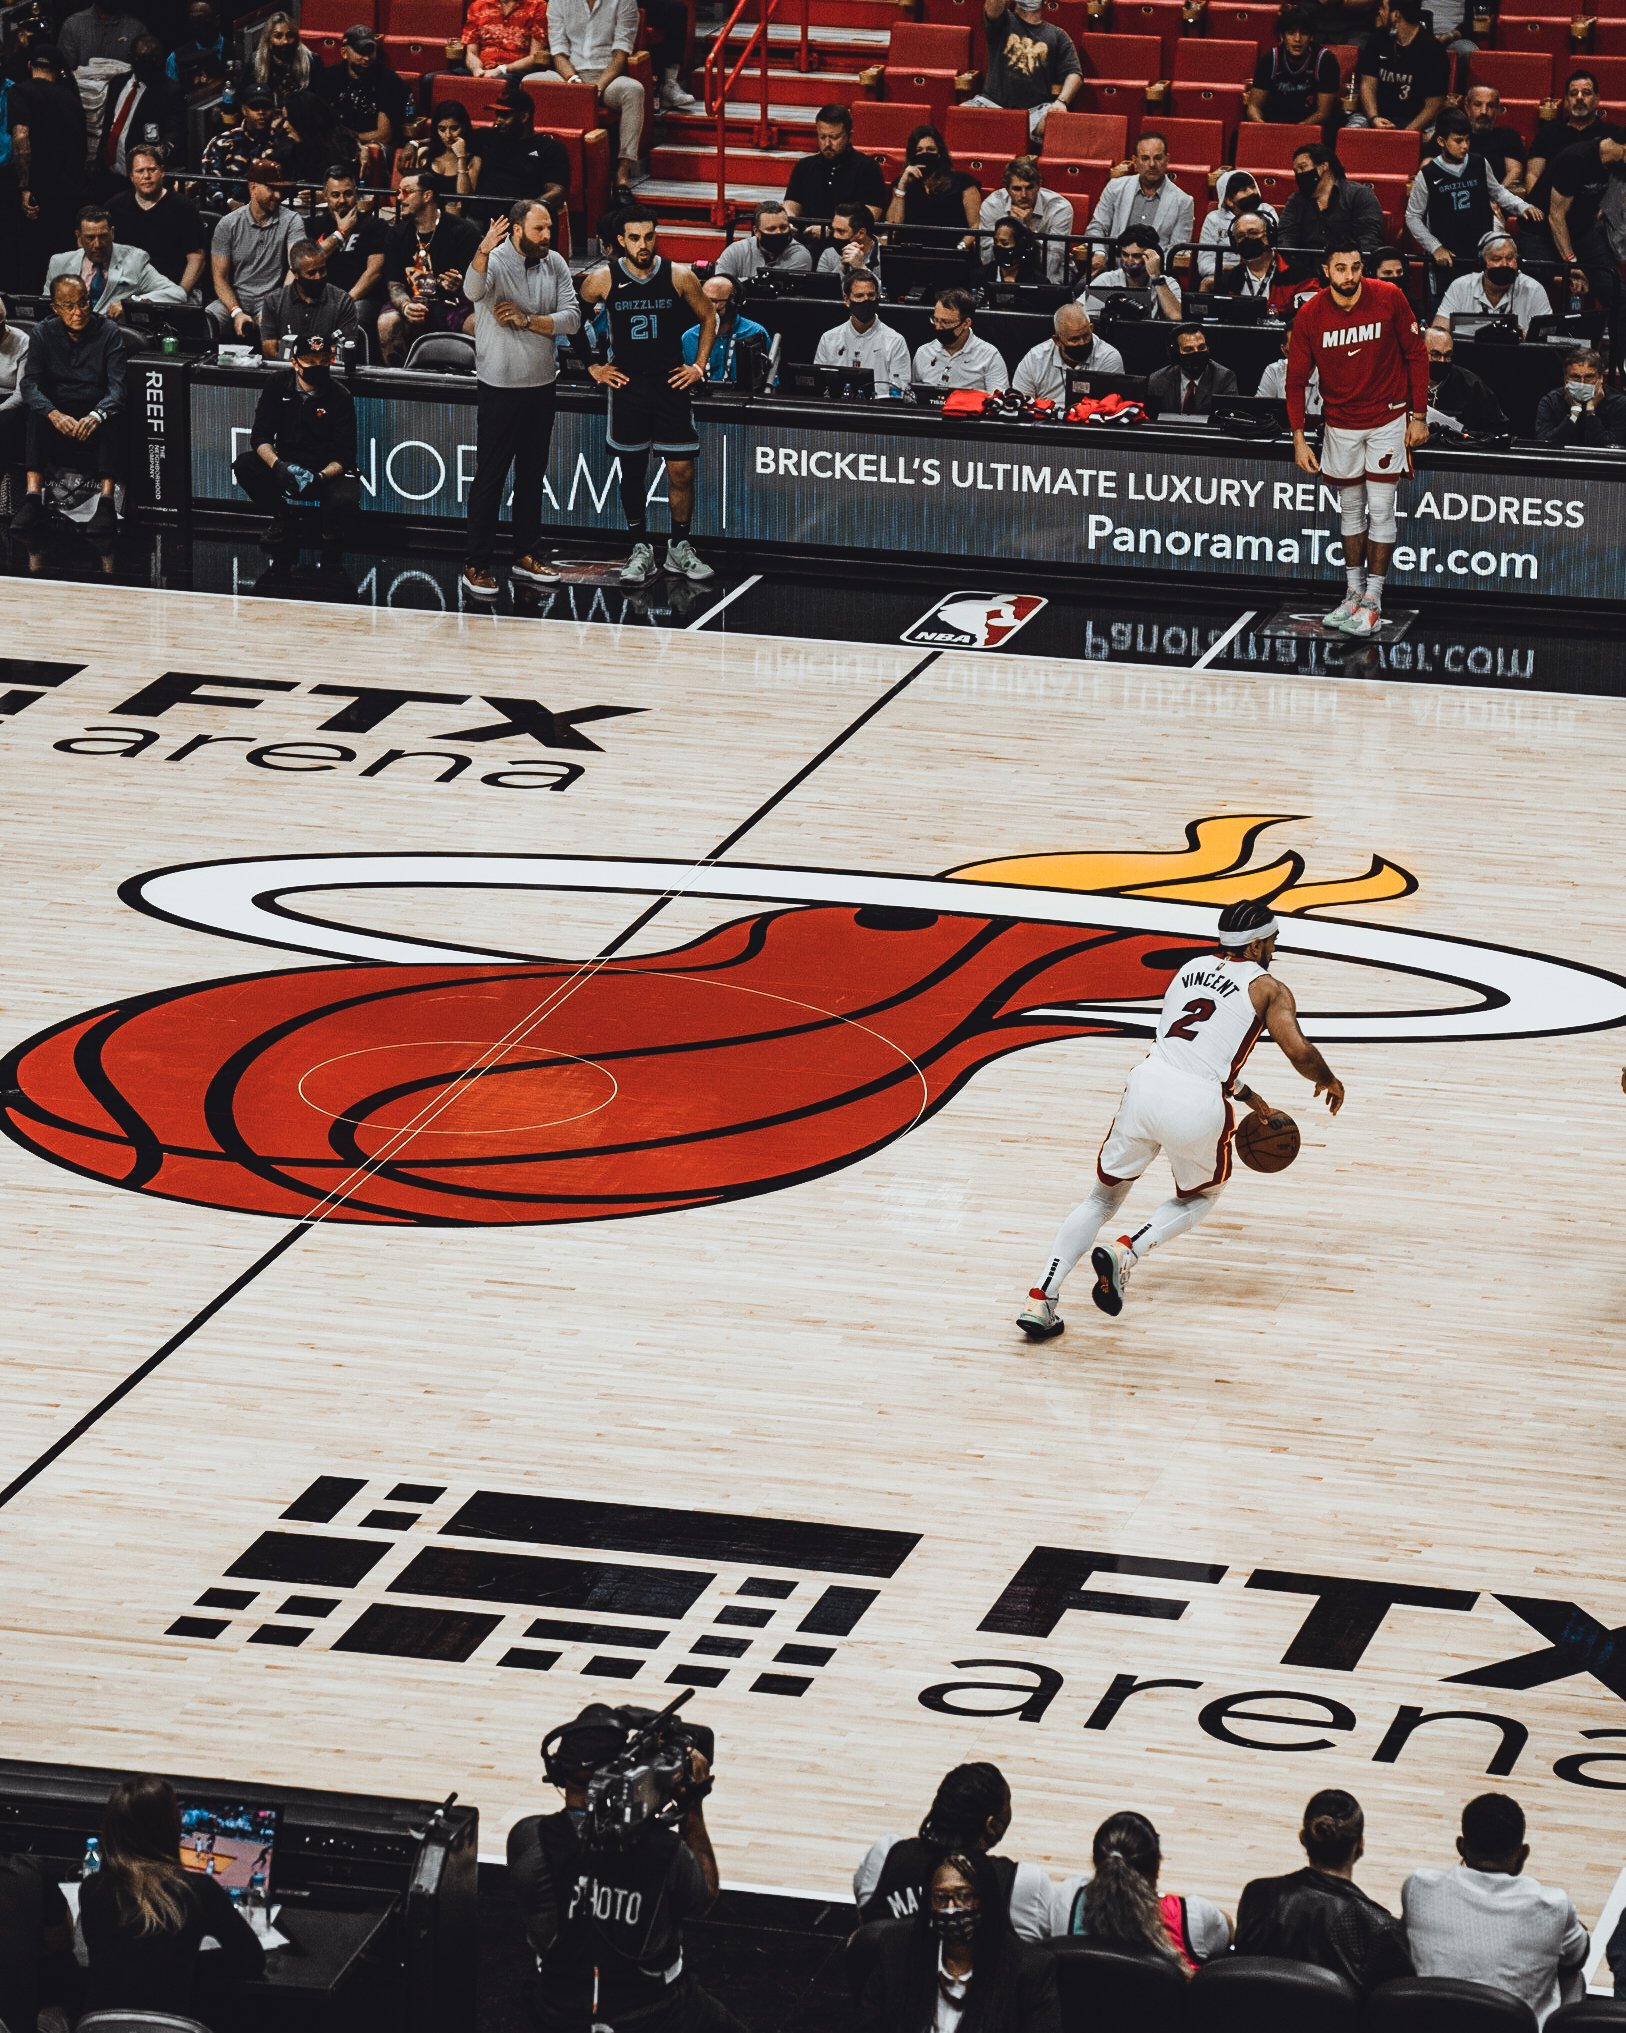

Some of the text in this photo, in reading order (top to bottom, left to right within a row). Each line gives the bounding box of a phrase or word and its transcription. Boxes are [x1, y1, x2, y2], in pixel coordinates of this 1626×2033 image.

[1399, 84, 1412, 101] 3
[1450, 190, 1471, 210] 12
[614, 298, 673, 311] GRIZZLIES
[630, 314, 658, 340] 21
[1322, 321, 1382, 348] MIAMI
[145, 370, 164, 433] REEF
[755, 446, 1585, 528] BRICKELL'S ULTIMATE LUXURY RENL ADDRESS
[1088, 513, 1538, 580] PanoramaToer.com
[914, 631, 971, 643] NBA
[108, 671, 653, 753] FTX
[53, 726, 586, 792] arena
[1181, 971, 1240, 998] VINCENT
[1163, 997, 1217, 1042] 2
[975, 1545, 1626, 1703] FTX
